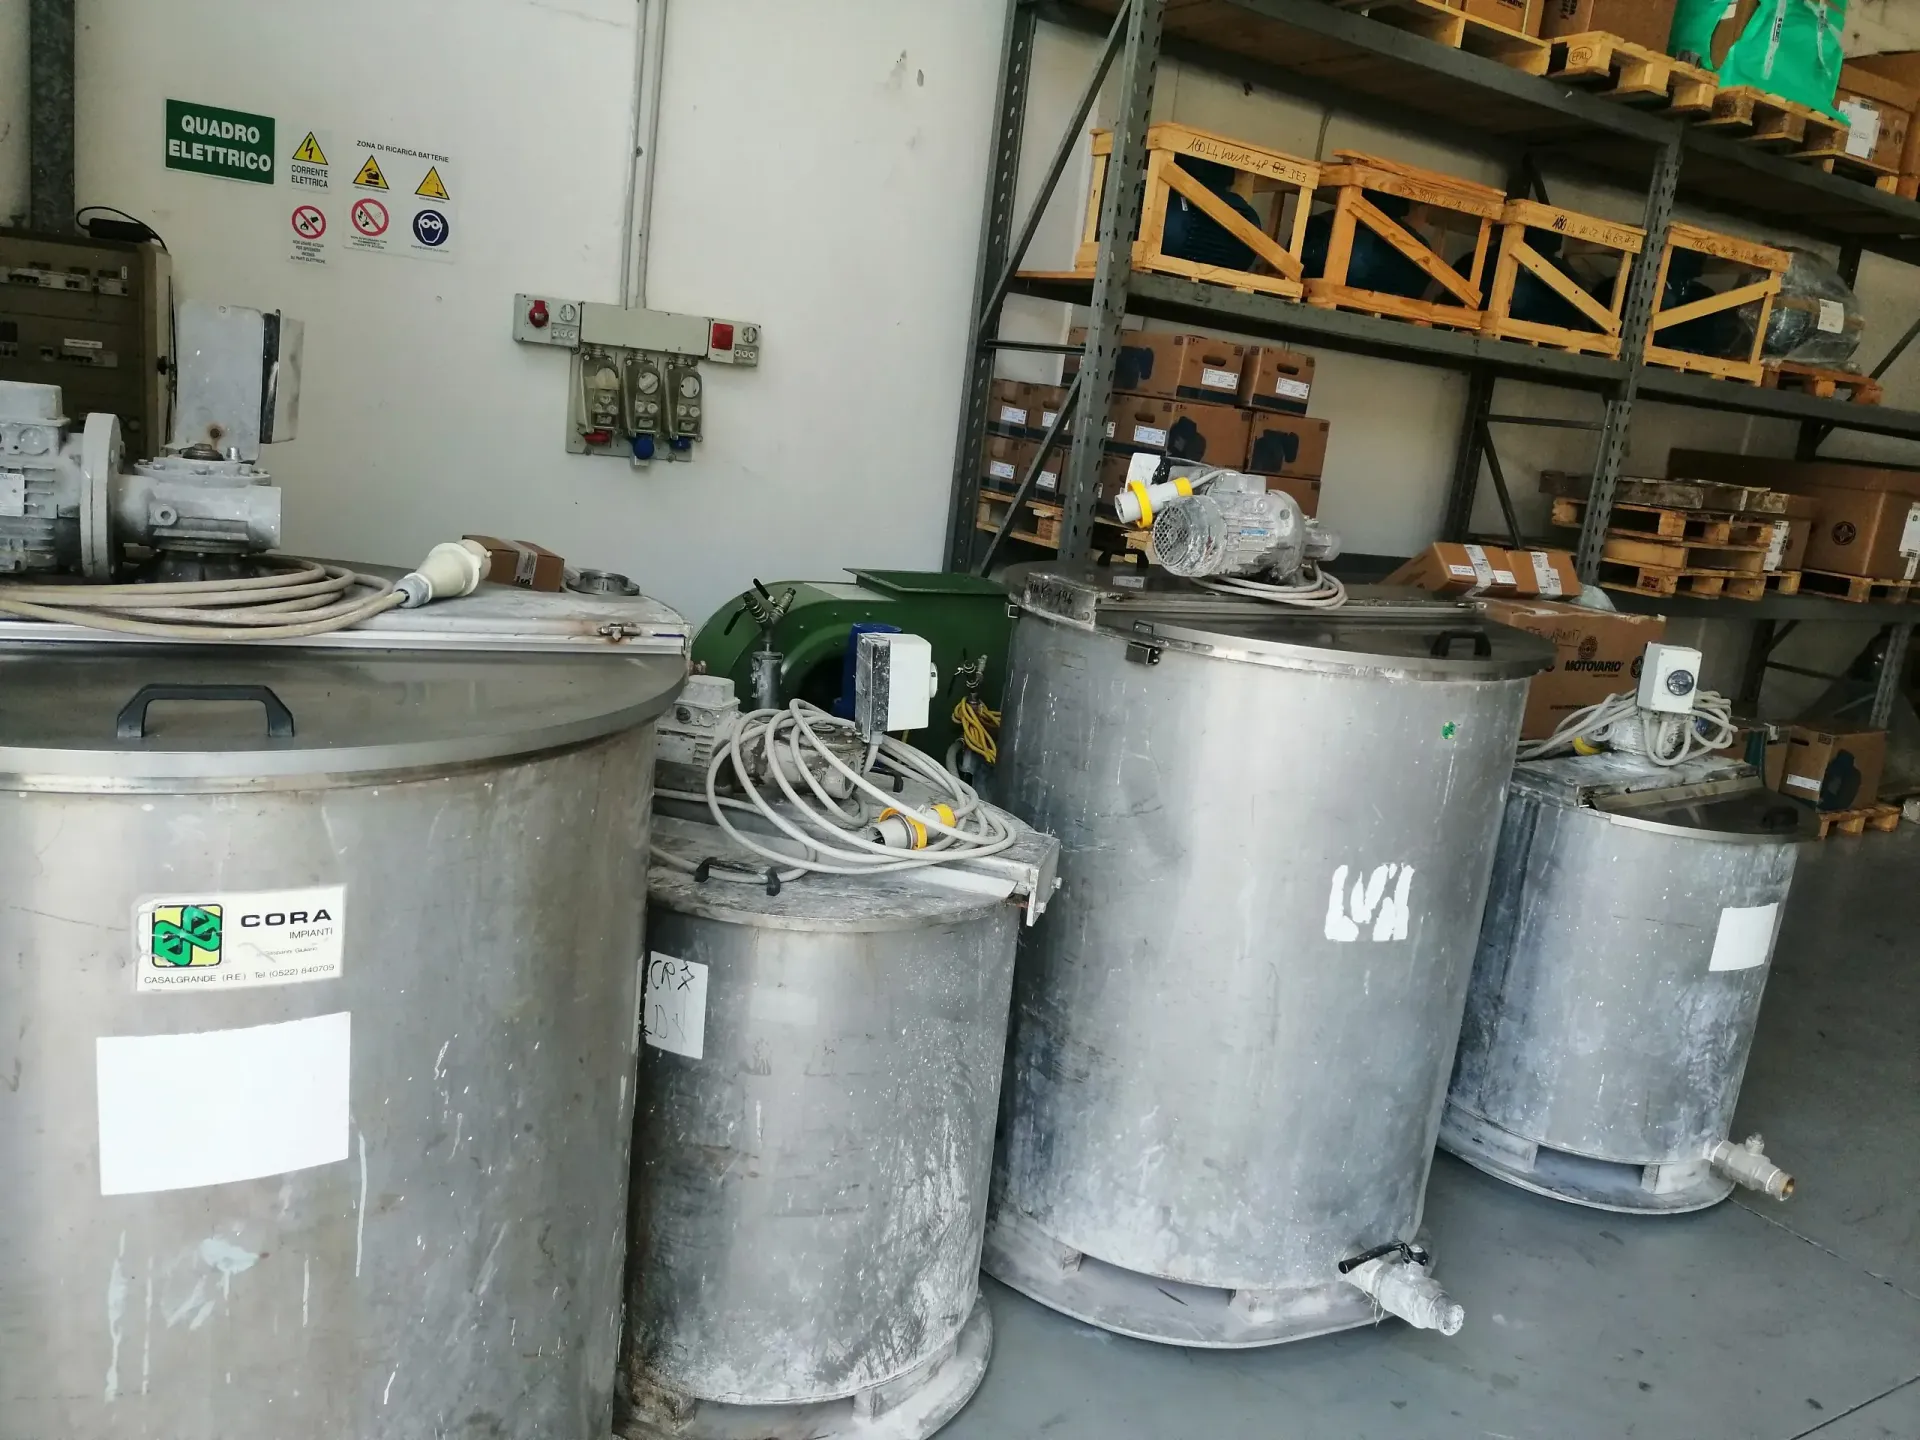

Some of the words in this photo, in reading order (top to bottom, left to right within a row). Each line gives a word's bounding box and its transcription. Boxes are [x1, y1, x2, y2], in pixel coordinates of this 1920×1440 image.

[181, 114, 260, 144] QUADRO
[168, 139, 272, 172] ELETTRICO
[356, 140, 376, 149] ZONA
[377, 143, 384, 151] DI
[385, 145, 417, 157] RICARICA
[418, 151, 449, 163] BATTERIE
[291, 164, 328, 178] CORRENTE
[291, 175, 329, 188] ELETTRICA
[1564, 660, 1622, 673] MOTOVARIO
[240, 909, 333, 928] CORA
[289, 927, 334, 940] IMPIANTI
[144, 974, 217, 985] CASALGRANDE
[269, 968, 299, 979] (0522)
[301, 963, 335, 975] 840709
